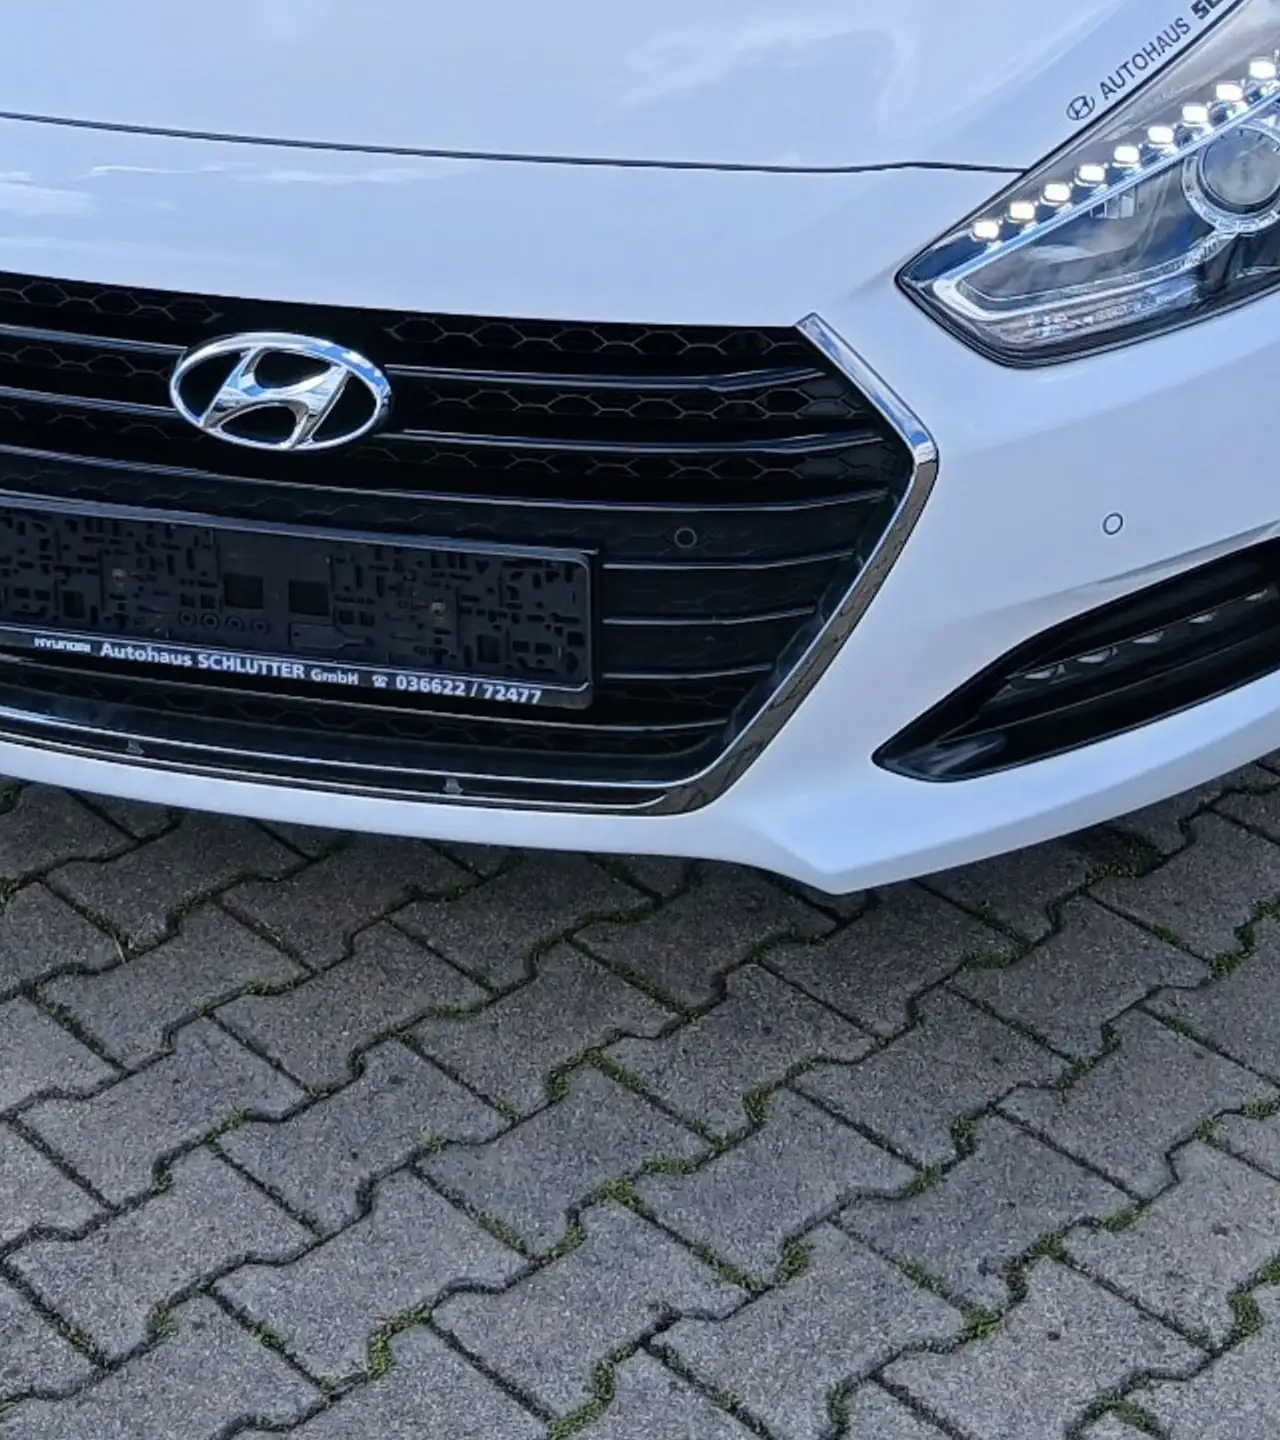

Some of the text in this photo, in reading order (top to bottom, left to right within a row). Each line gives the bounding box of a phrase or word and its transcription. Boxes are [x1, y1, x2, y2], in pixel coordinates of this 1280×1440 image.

[1099, 17, 1191, 100] AUTOHAUS
[100, 642, 193, 667] Autohaus
[197, 653, 305, 680] SCHLUTTER
[310, 668, 359, 686] GmbH
[395, 675, 466, 697] 036622
[482, 683, 542, 705] 72477
